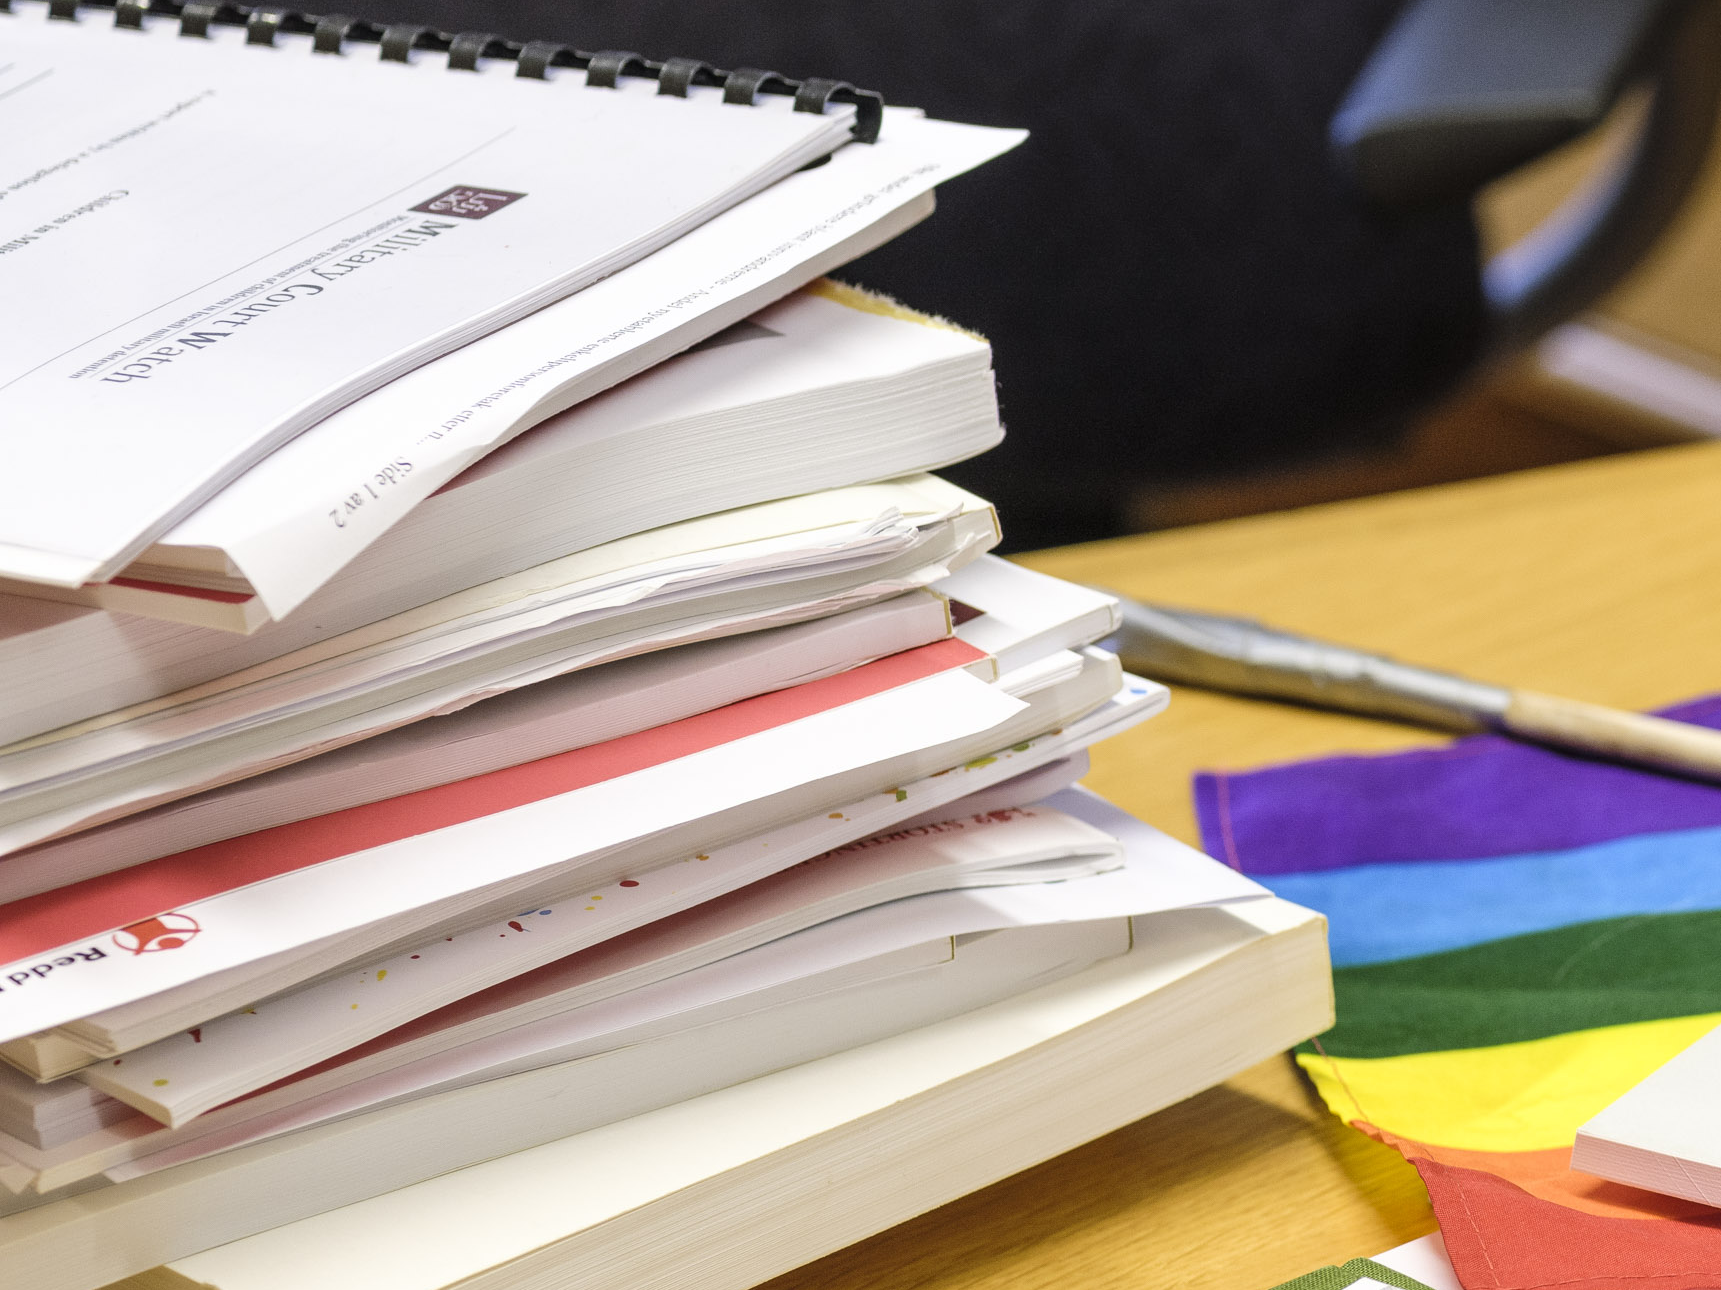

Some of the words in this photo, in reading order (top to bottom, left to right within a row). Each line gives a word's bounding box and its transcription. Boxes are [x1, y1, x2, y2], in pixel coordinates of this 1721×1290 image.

[53, 189, 129, 224] Children
[33, 223, 59, 234] in
[341, 214, 409, 244] Monitoring
[311, 220, 459, 282] Military
[331, 242, 350, 254] the
[279, 251, 331, 278] treatment
[217, 279, 265, 306] children
[262, 274, 278, 286] of
[203, 302, 220, 315] in
[212, 282, 325, 328] Court
[667, 288, 710, 310] Andel
[168, 310, 209, 330] Israeli
[599, 301, 674, 345] nyetablerte
[123, 326, 171, 351] military
[68, 348, 128, 380] detention
[100, 330, 234, 384] Watch
[471, 339, 601, 410] enkeltpersonforetak
[441, 408, 475, 433] etter
[375, 456, 416, 487] Side
[343, 492, 365, 517] av
[363, 484, 382, 500] 1
[329, 508, 347, 529] 2
[7, 946, 109, 987] Redd
